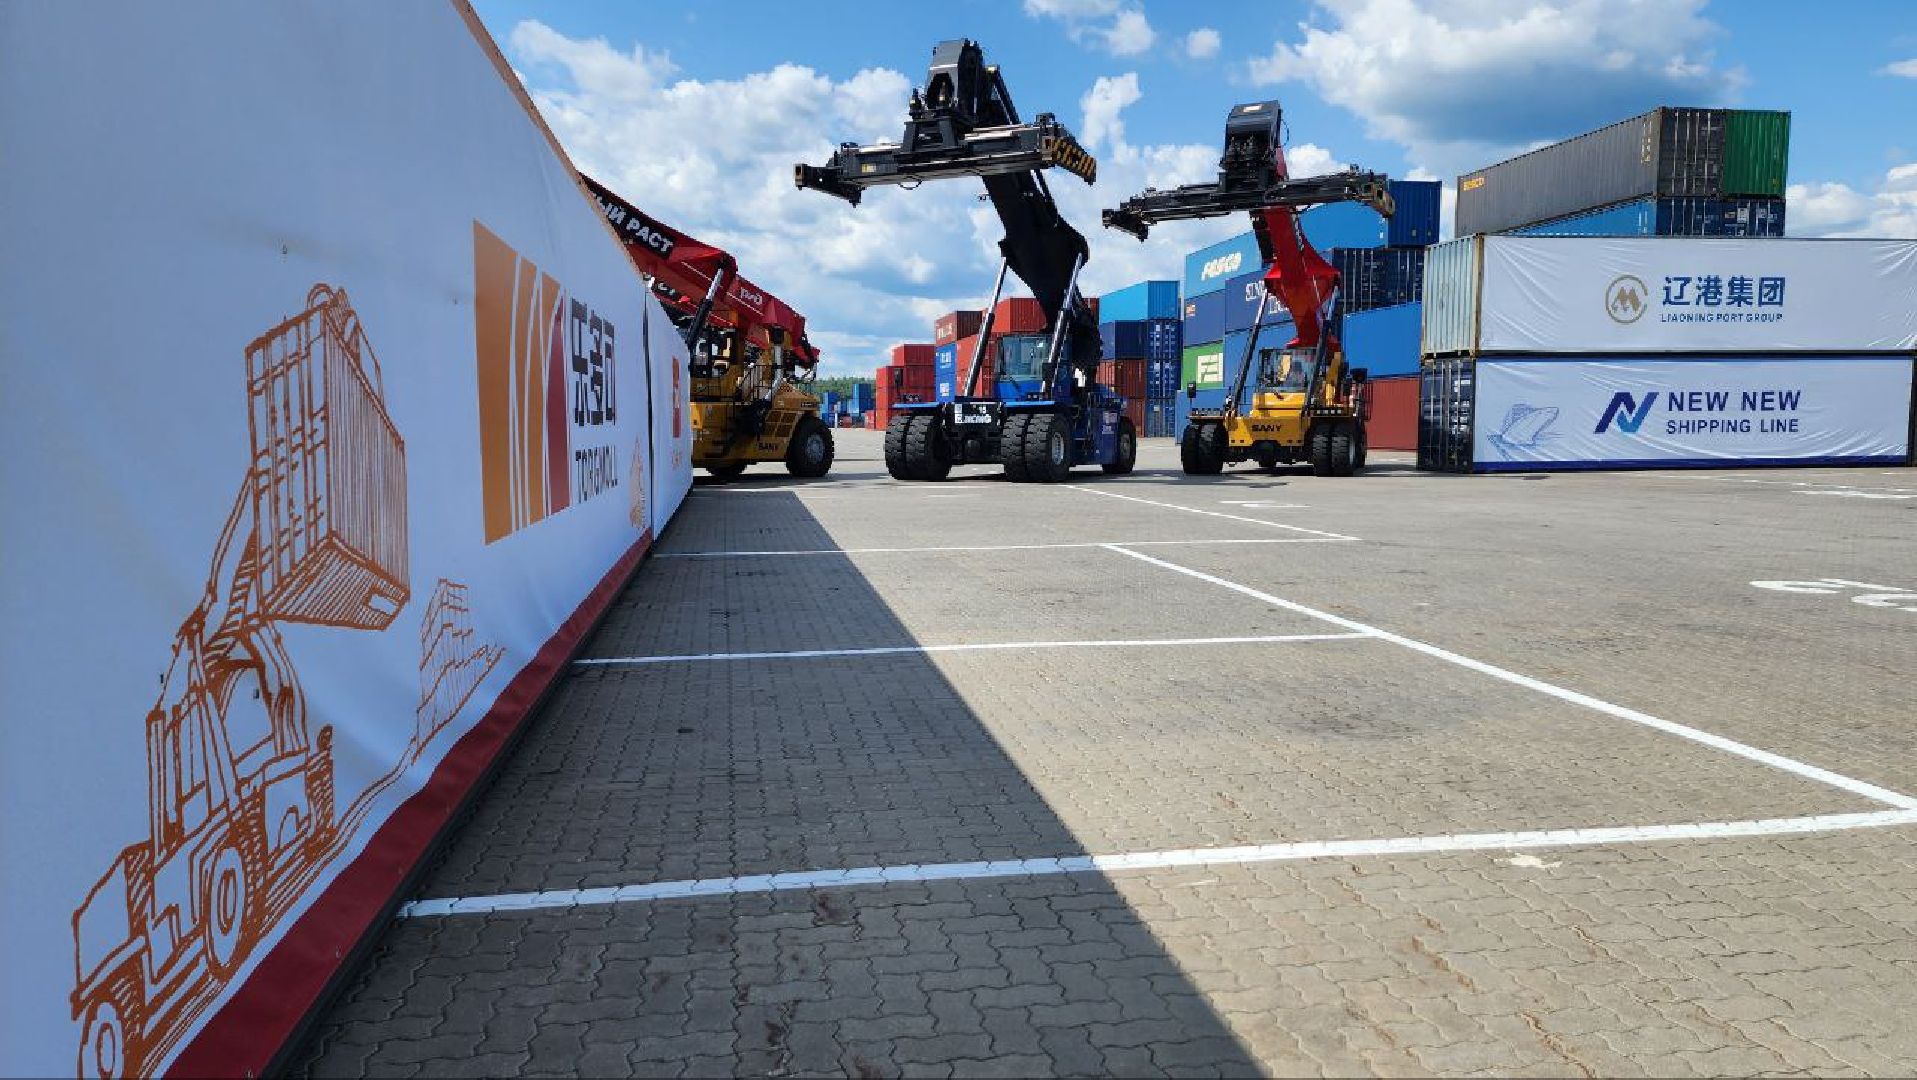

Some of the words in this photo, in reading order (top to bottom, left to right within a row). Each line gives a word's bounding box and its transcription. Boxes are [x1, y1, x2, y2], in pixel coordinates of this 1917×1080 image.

[590, 190, 626, 224] ЫЙ
[626, 217, 673, 252] РАСТ
[1662, 275, 1785, 307] 辽港集团
[1661, 313, 1714, 323] LIAONING
[1717, 313, 1743, 323] PORT
[1746, 313, 1783, 323] GROUP
[1668, 392, 1728, 411] NEW
[1741, 391, 1801, 411] NEW
[1252, 424, 1282, 432] SANY
[1665, 419, 1751, 434] SHIPPING
[1760, 419, 1799, 433] LINE
